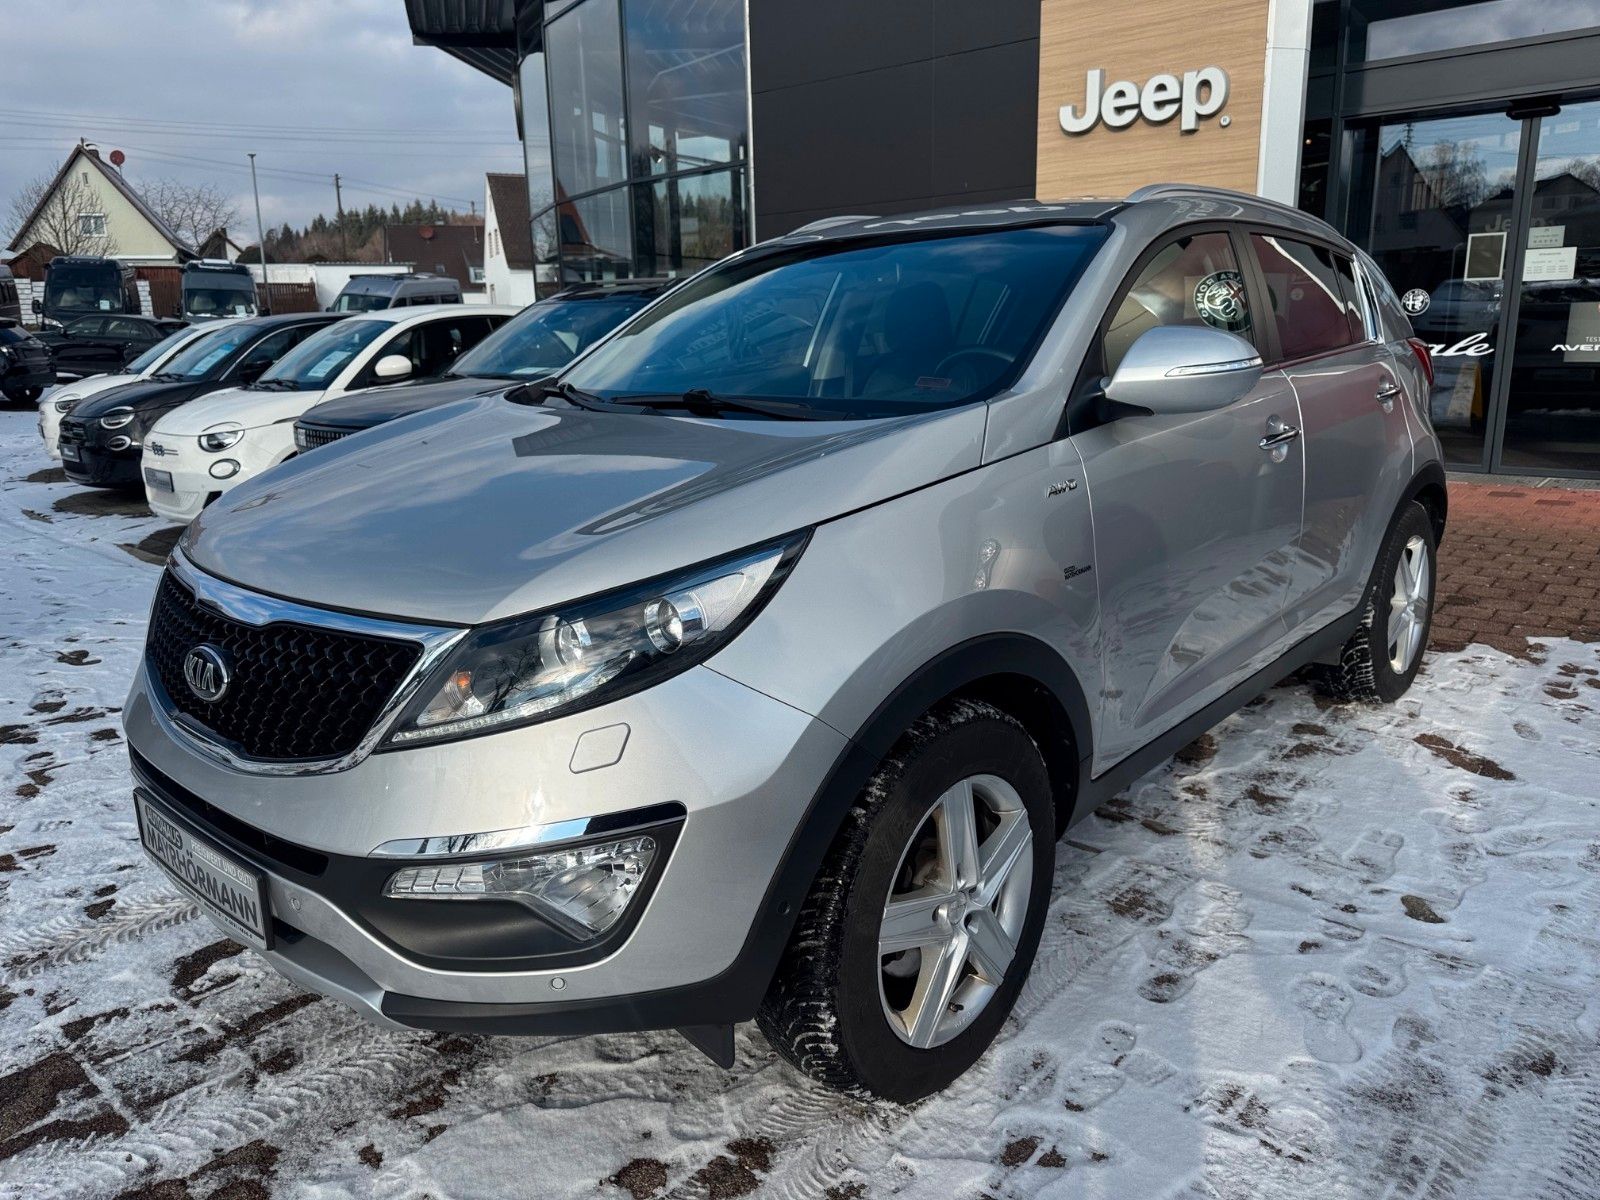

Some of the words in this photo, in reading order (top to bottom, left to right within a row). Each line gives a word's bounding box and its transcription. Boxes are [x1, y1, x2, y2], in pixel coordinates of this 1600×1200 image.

[1059, 67, 1229, 133] Jeep
[186, 654, 215, 693] KIA
[147, 825, 258, 928] MAYRHÖRMANN
[191, 840, 222, 868] PREISWERT
[223, 860, 237, 878] UND
